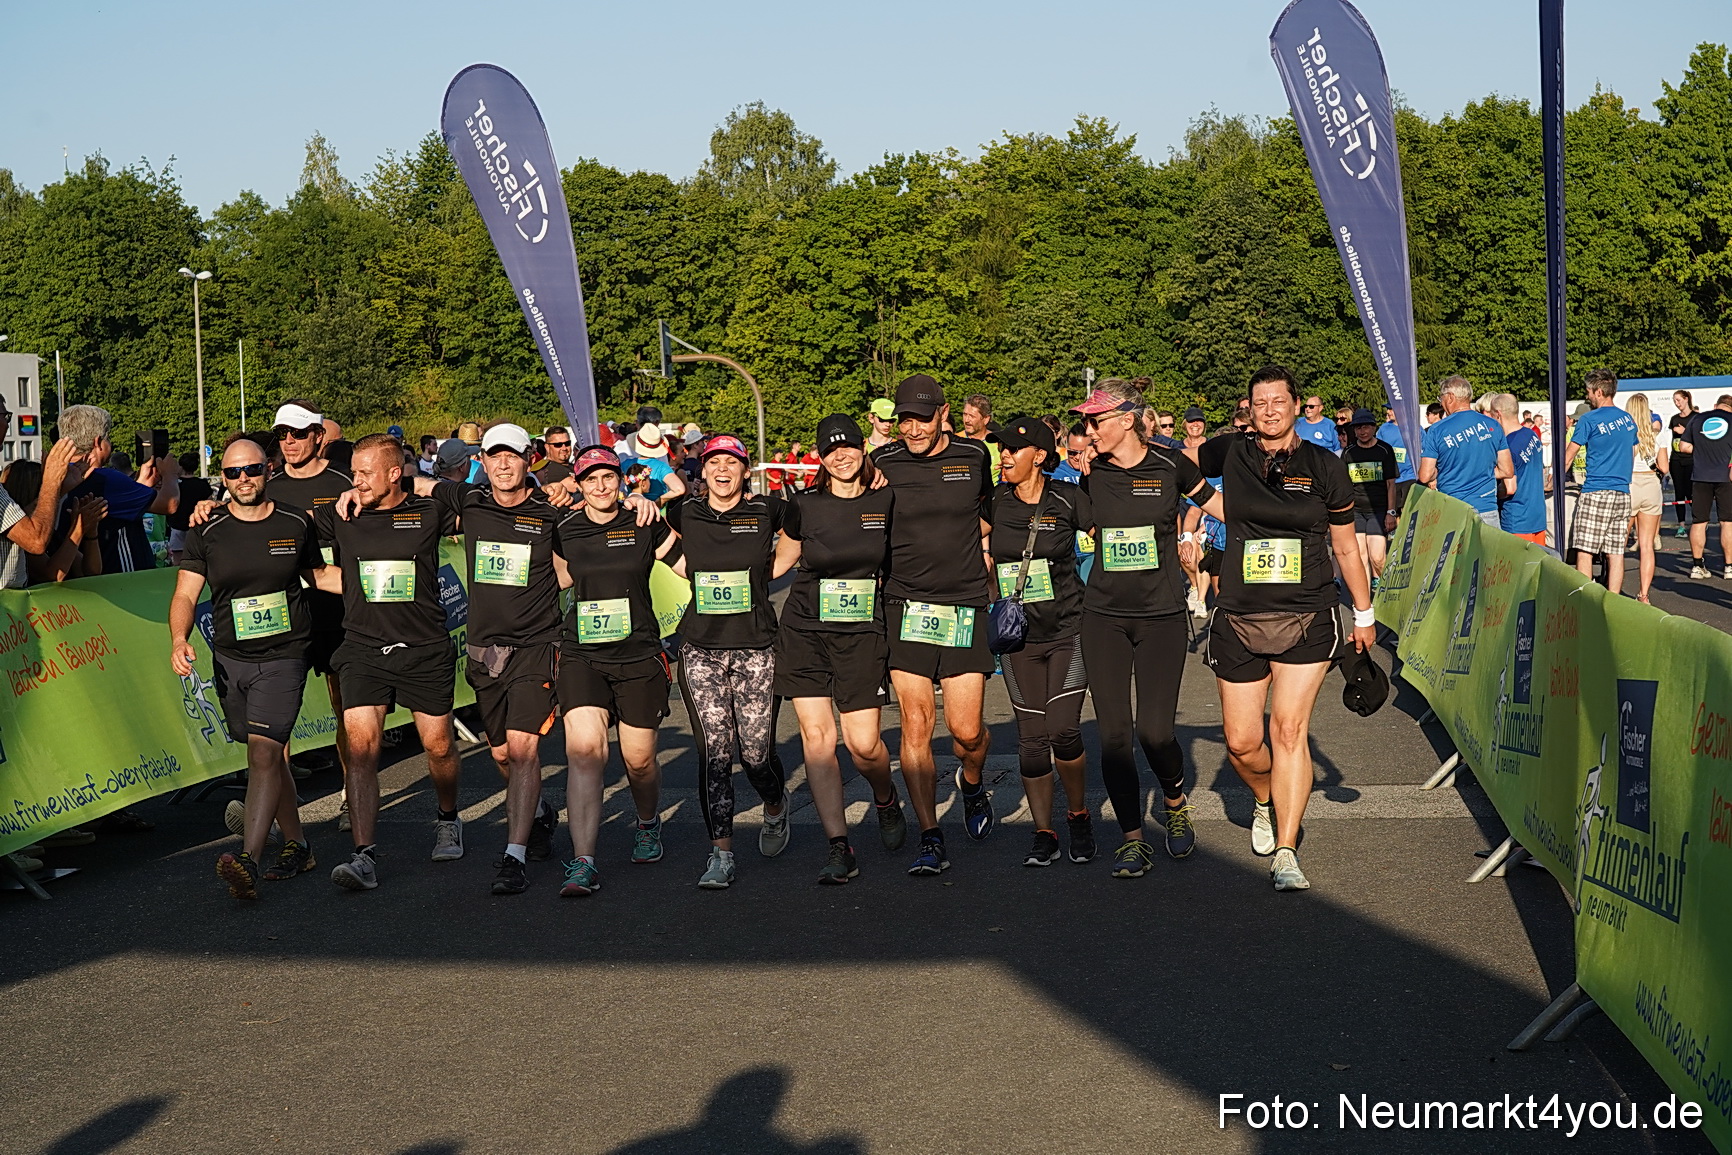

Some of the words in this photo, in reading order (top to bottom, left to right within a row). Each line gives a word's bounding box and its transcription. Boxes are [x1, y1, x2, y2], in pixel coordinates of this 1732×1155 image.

[1110, 542, 1148, 556] 1508
[488, 556, 514, 572] 198
[1257, 554, 1287, 568] 580
[440, 583, 461, 600] Fischer
[1042, 575, 1051, 594] 2022
[712, 586, 732, 600] 66
[840, 594, 858, 608] 54
[26, 603, 85, 639] Firmen
[252, 609, 272, 624] 94
[281, 607, 289, 626] 2022
[593, 614, 610, 629] 57
[922, 616, 940, 630] 59
[6, 653, 65, 698] laufen
[56, 623, 119, 672] länger!
[1623, 725, 1646, 753] Fischer
[1593, 805, 1689, 919] firmenlauf
[1586, 893, 1628, 933] neumarkt
